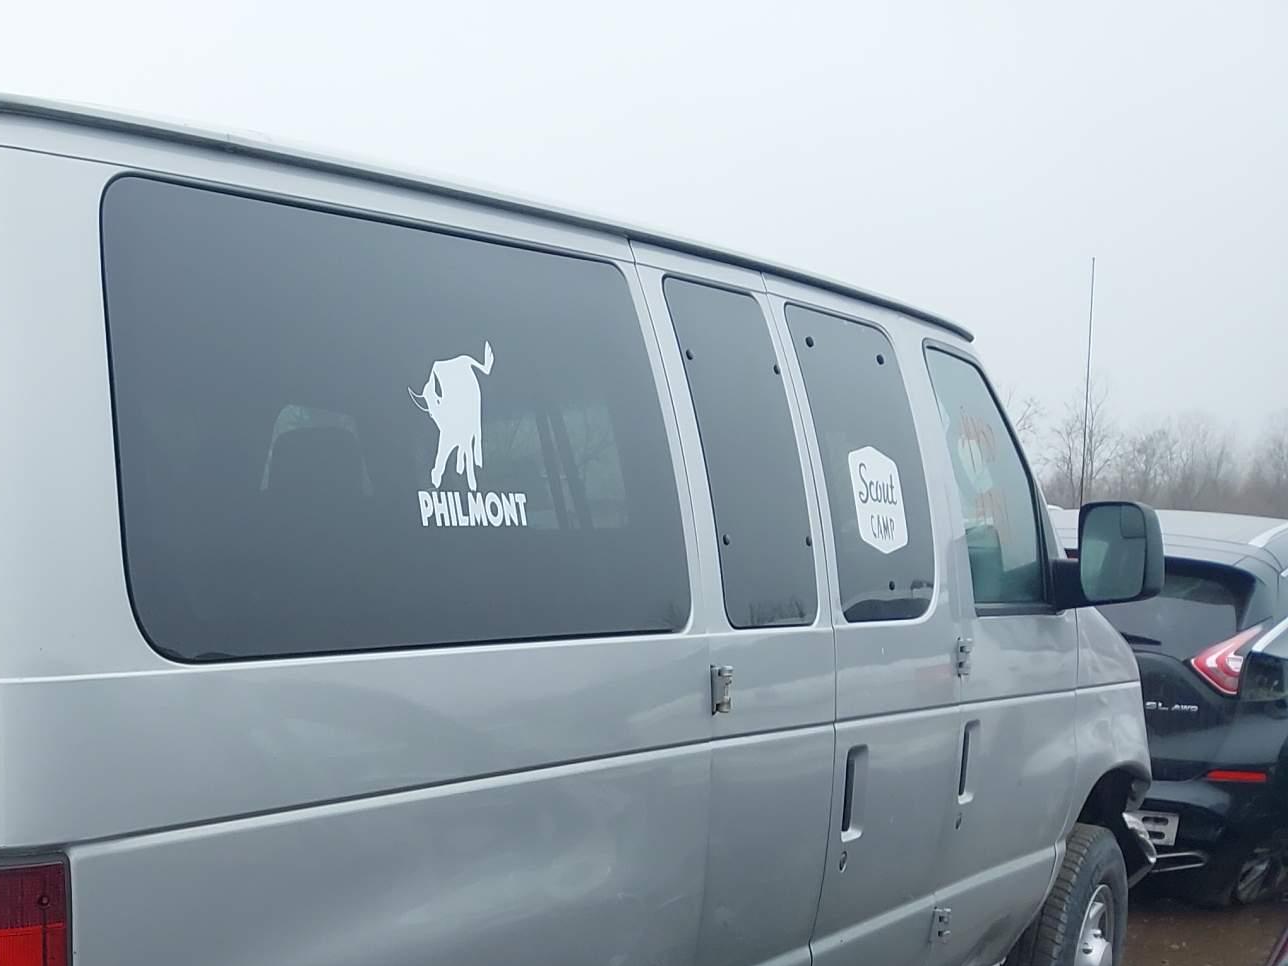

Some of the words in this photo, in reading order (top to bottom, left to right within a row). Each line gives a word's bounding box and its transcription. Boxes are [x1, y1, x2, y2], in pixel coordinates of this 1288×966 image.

[858, 462, 898, 505] Scout
[418, 490, 528, 527] PHILMONT
[870, 514, 895, 540] CAMP
